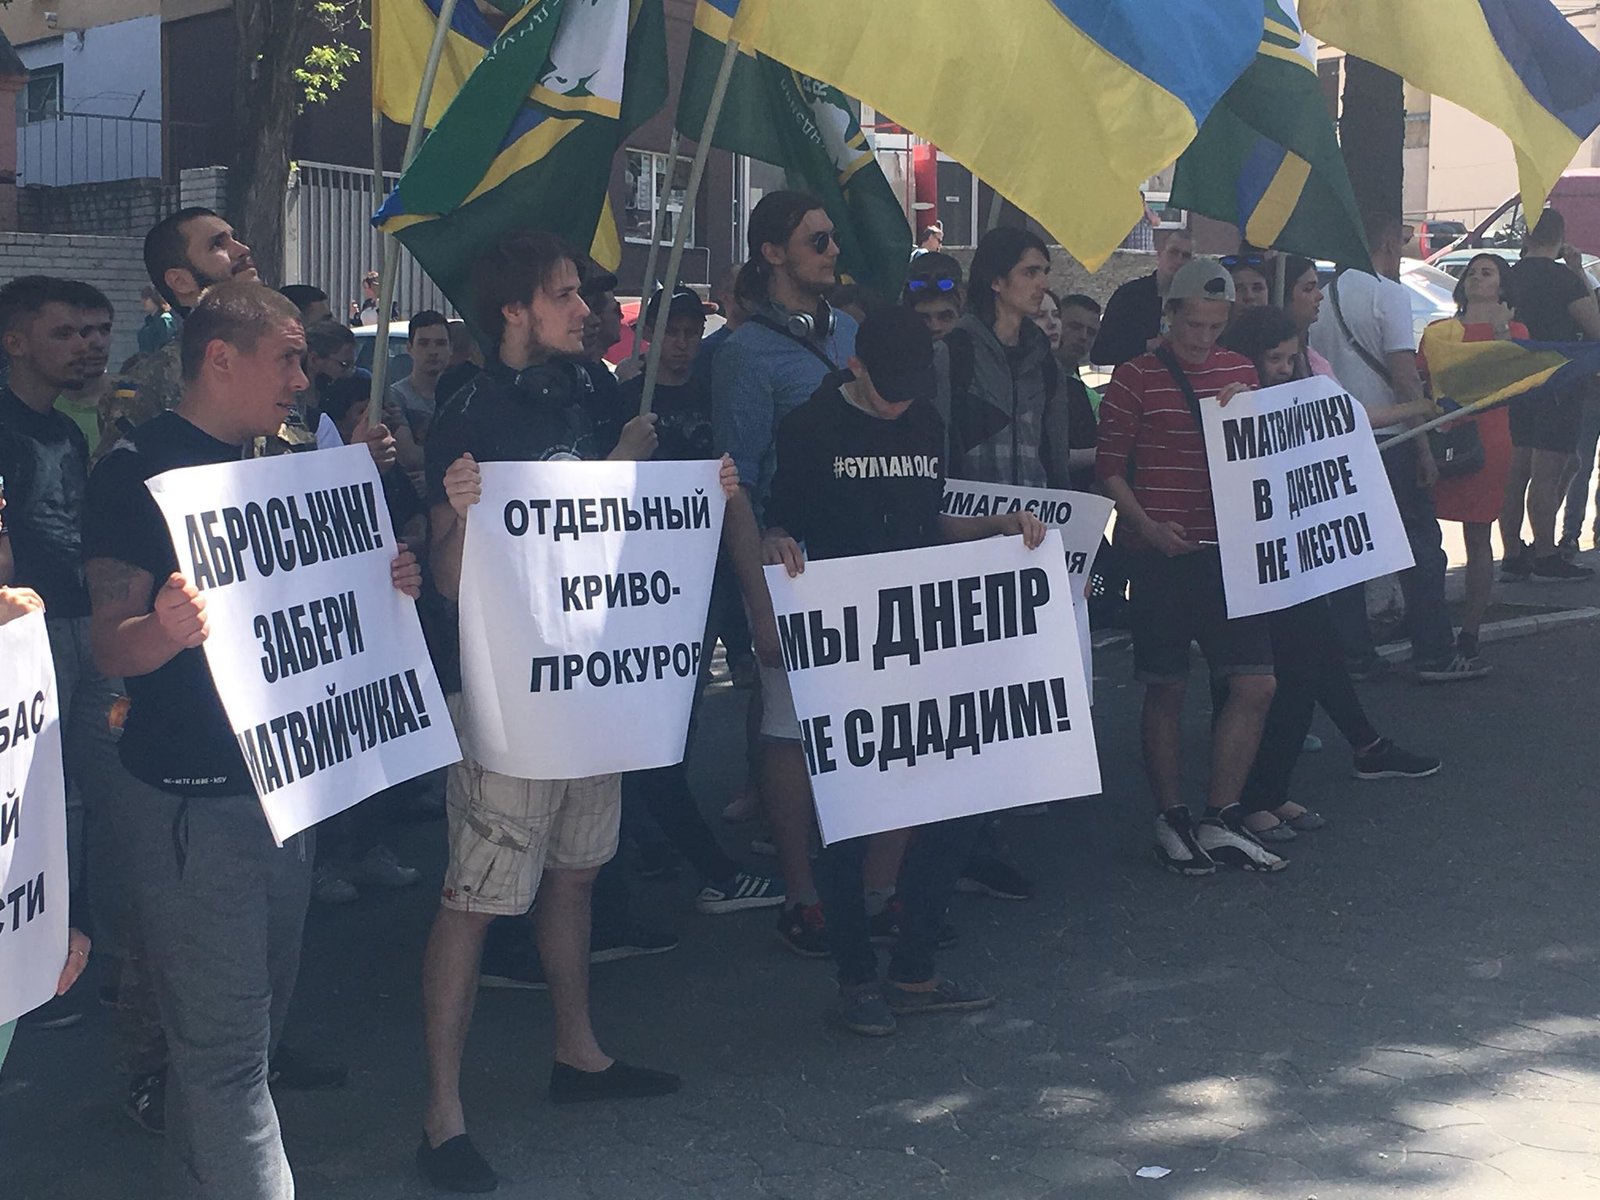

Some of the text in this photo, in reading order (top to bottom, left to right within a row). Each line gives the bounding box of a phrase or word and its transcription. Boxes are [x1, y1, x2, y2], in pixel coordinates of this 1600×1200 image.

[1222, 394, 1356, 462] МАТВИЙЧУКУ
[504, 488, 711, 541] ОТДЕЛЬНЫЙ
[1252, 455, 1358, 521] В ДНЕПРЕ
[184, 481, 383, 591] АБРОСЬКИН!
[1256, 512, 1375, 584] НЕ МЕСТО!
[561, 569, 681, 612] КРИВО-
[777, 567, 1050, 672] МЫ ДНЕПР
[253, 590, 365, 683] ЗАБЕРИ
[799, 677, 1071, 776] НЕ СДАДИМ!
